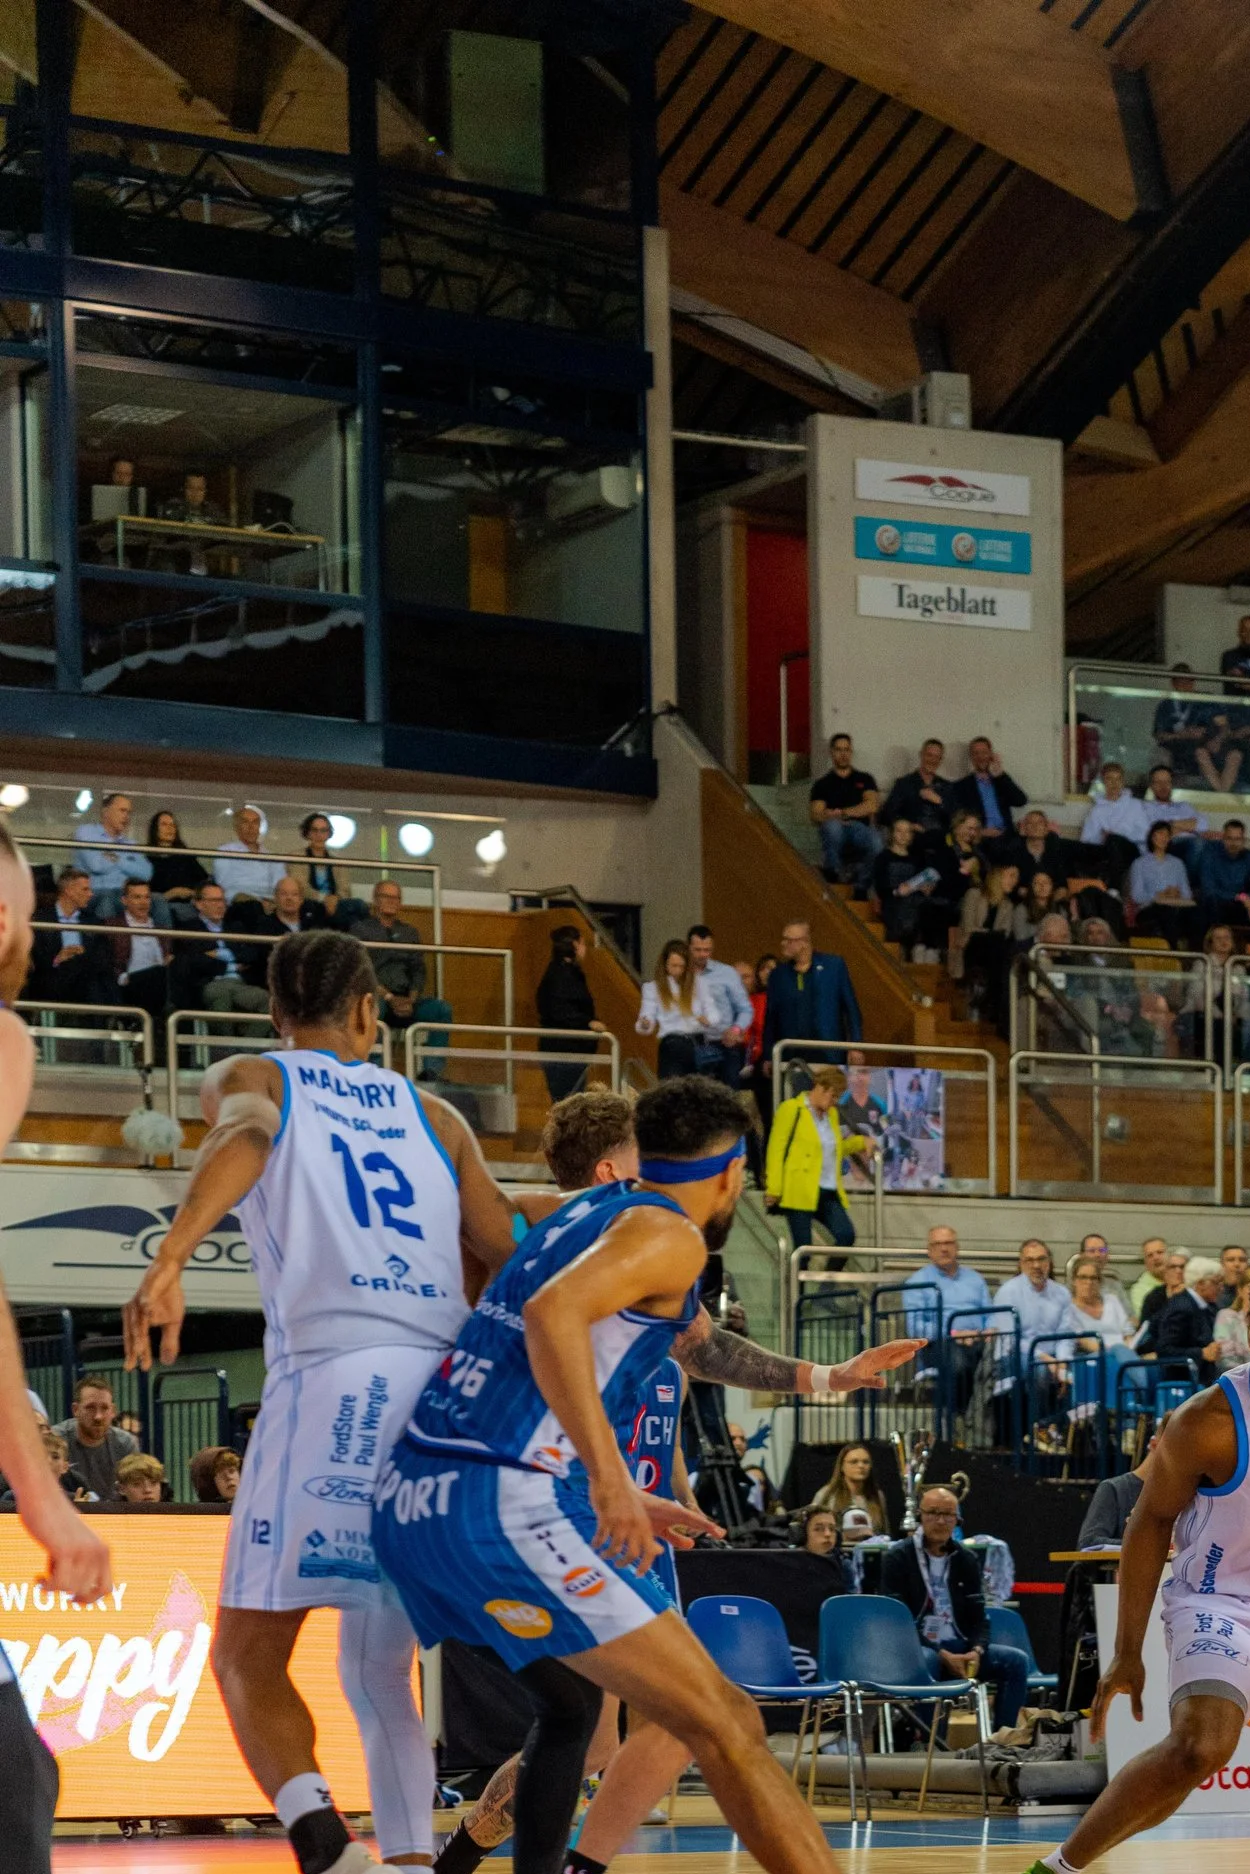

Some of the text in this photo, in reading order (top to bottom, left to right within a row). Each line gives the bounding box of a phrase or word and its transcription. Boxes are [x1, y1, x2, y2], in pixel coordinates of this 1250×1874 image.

[893, 582, 997, 618] Tageblatt
[330, 1133, 425, 1241] 12
[329, 1394, 357, 1464] FordStore
[354, 1374, 389, 1466] Paul Wengler
[251, 1518, 271, 1545] 12
